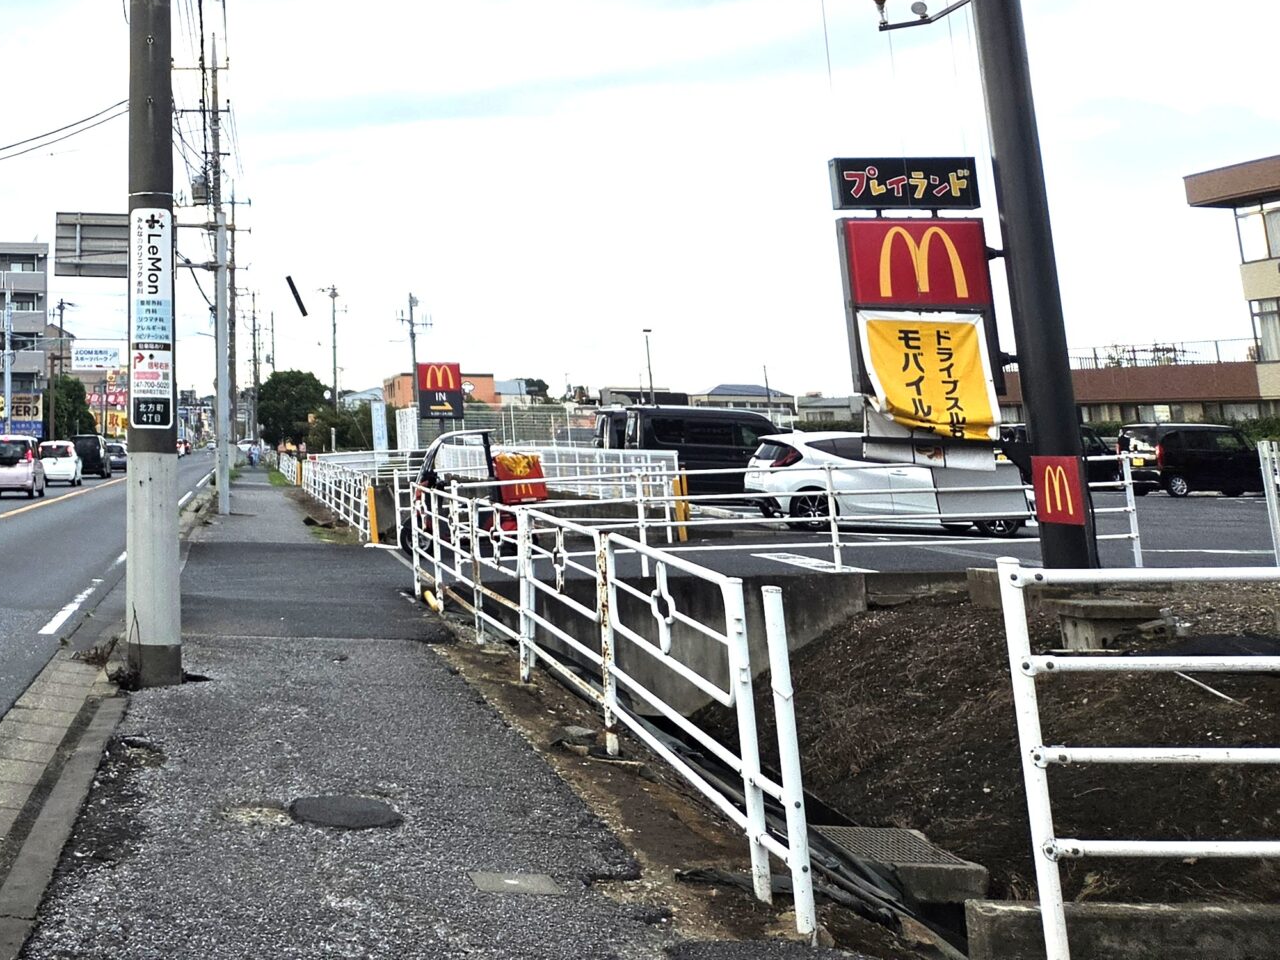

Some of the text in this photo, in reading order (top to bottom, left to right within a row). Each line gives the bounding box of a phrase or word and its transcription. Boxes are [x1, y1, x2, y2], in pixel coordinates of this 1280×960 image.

[843, 166, 970, 198] プレイランド
[147, 233, 162, 295] LeMon
[435, 392, 447, 401] IN
[139, 403, 164, 412] 北方町
